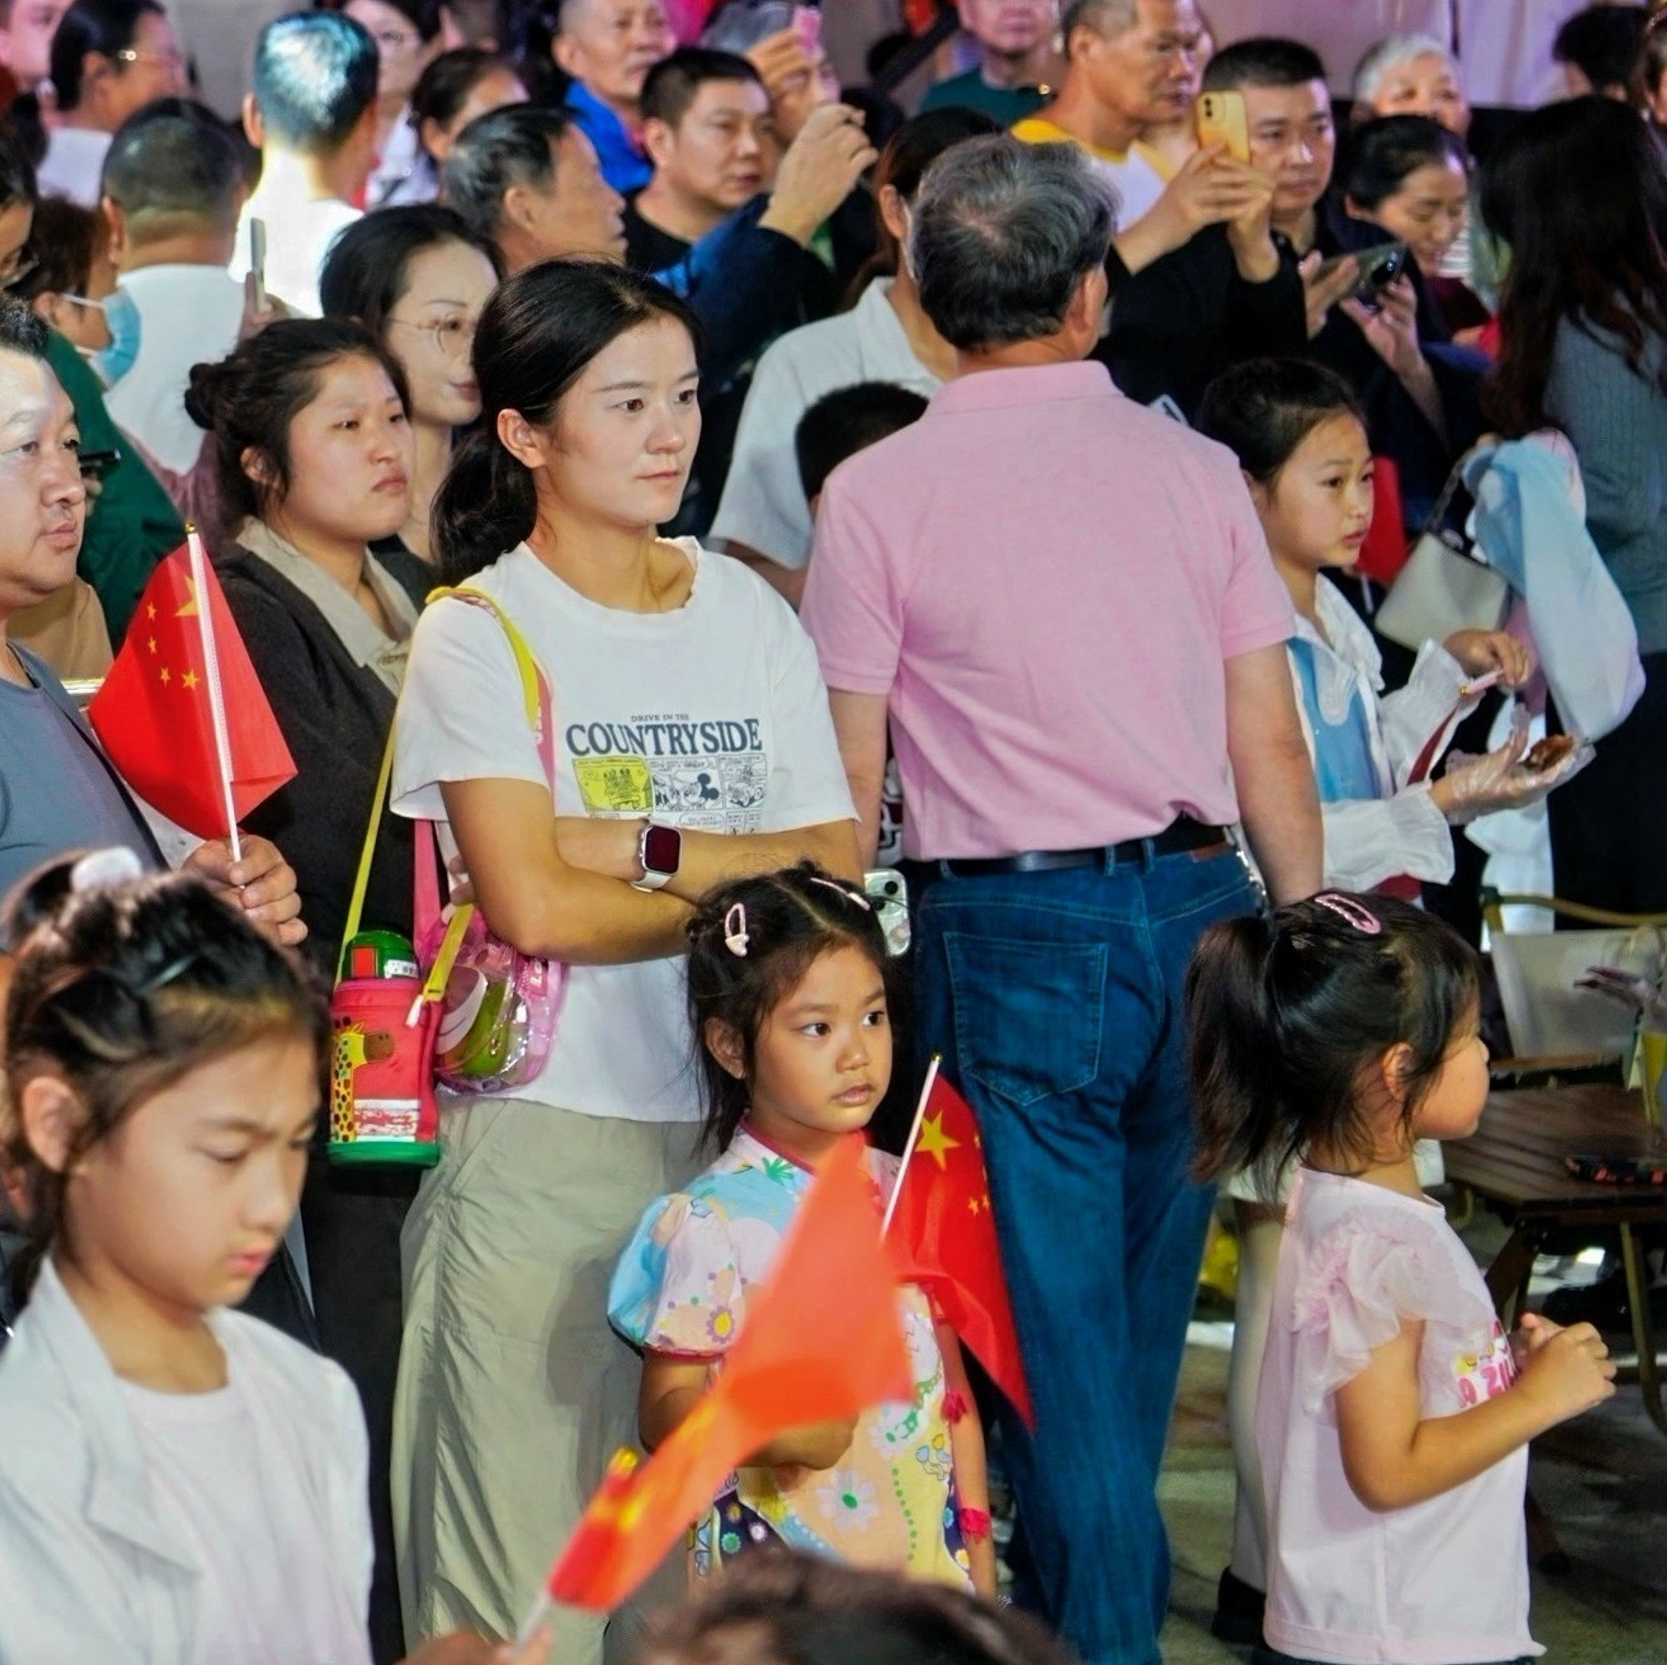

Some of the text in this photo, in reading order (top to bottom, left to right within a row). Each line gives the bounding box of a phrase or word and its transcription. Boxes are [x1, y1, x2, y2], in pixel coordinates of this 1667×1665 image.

[631, 714, 661, 722] DRIVE
[676, 713, 689, 721] THE
[565, 718, 763, 757] COUNTRYSIDE
